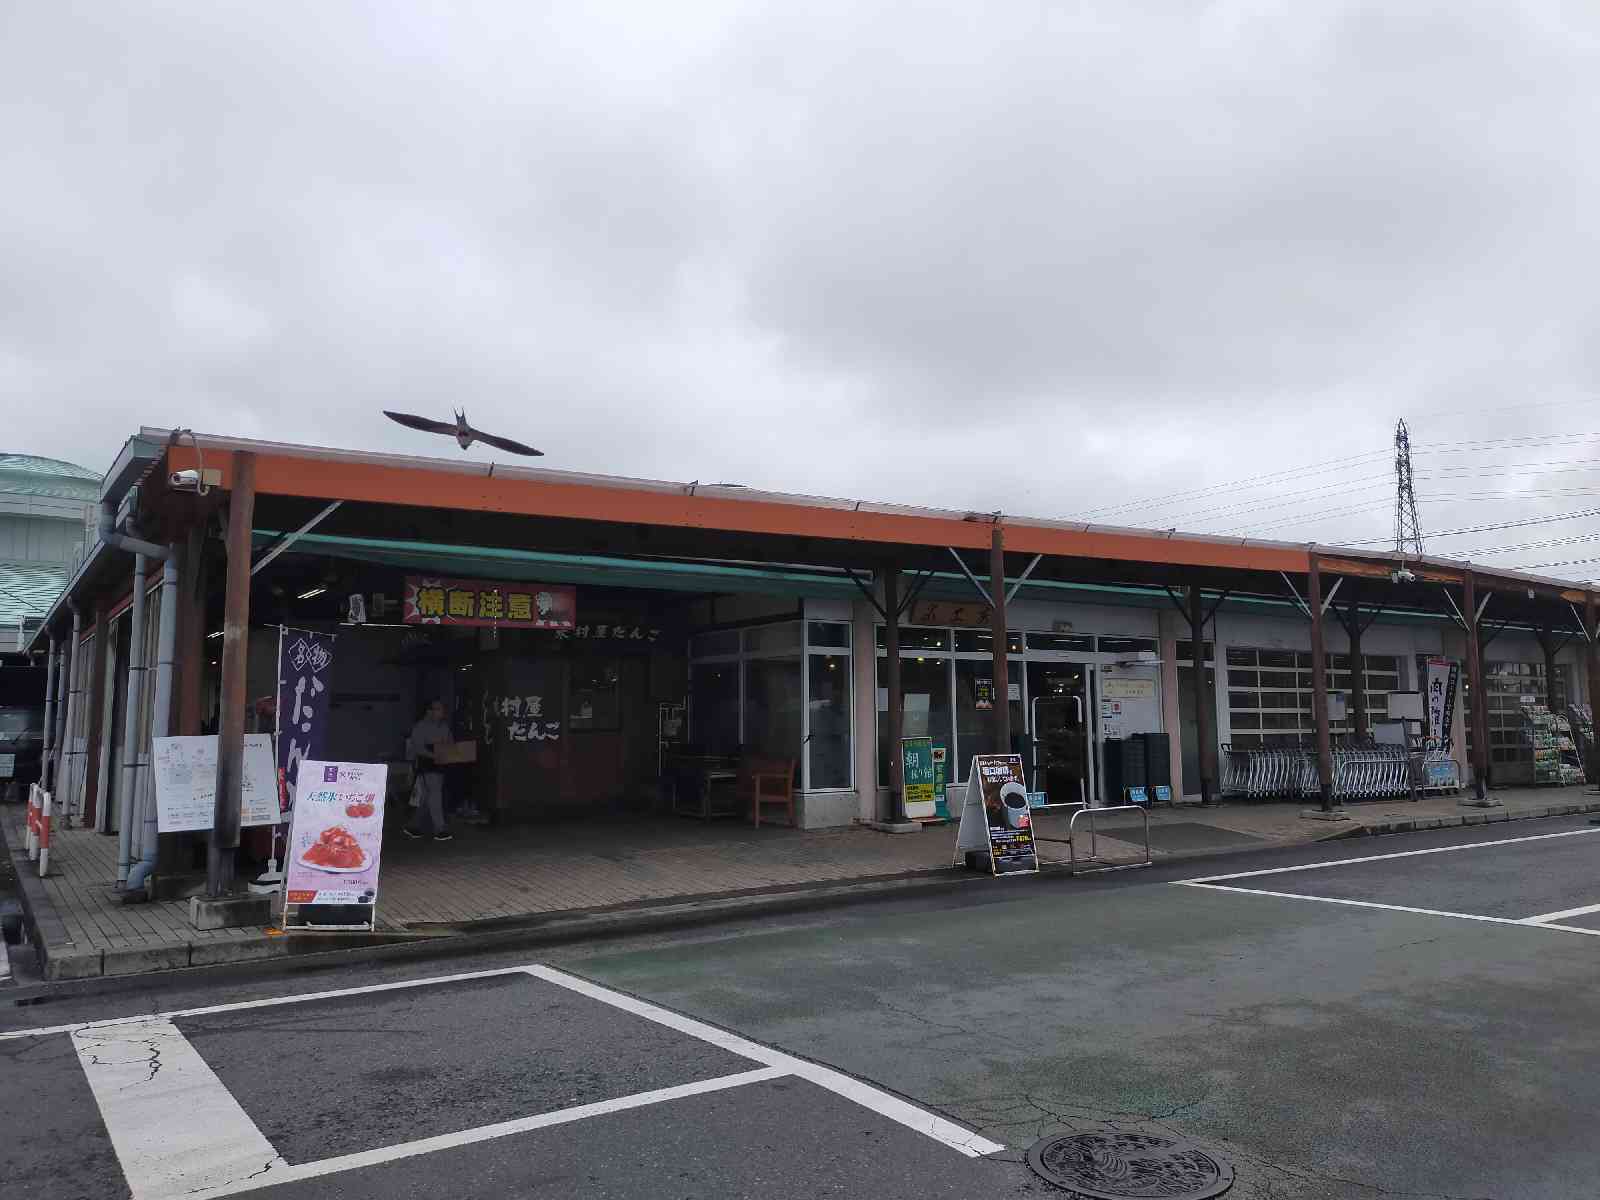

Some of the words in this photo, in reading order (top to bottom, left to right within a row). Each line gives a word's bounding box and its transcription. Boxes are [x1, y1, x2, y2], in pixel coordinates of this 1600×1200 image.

[418, 588, 535, 620] 横断注意
[292, 641, 330, 671] 名物
[505, 720, 561, 742] だんご
